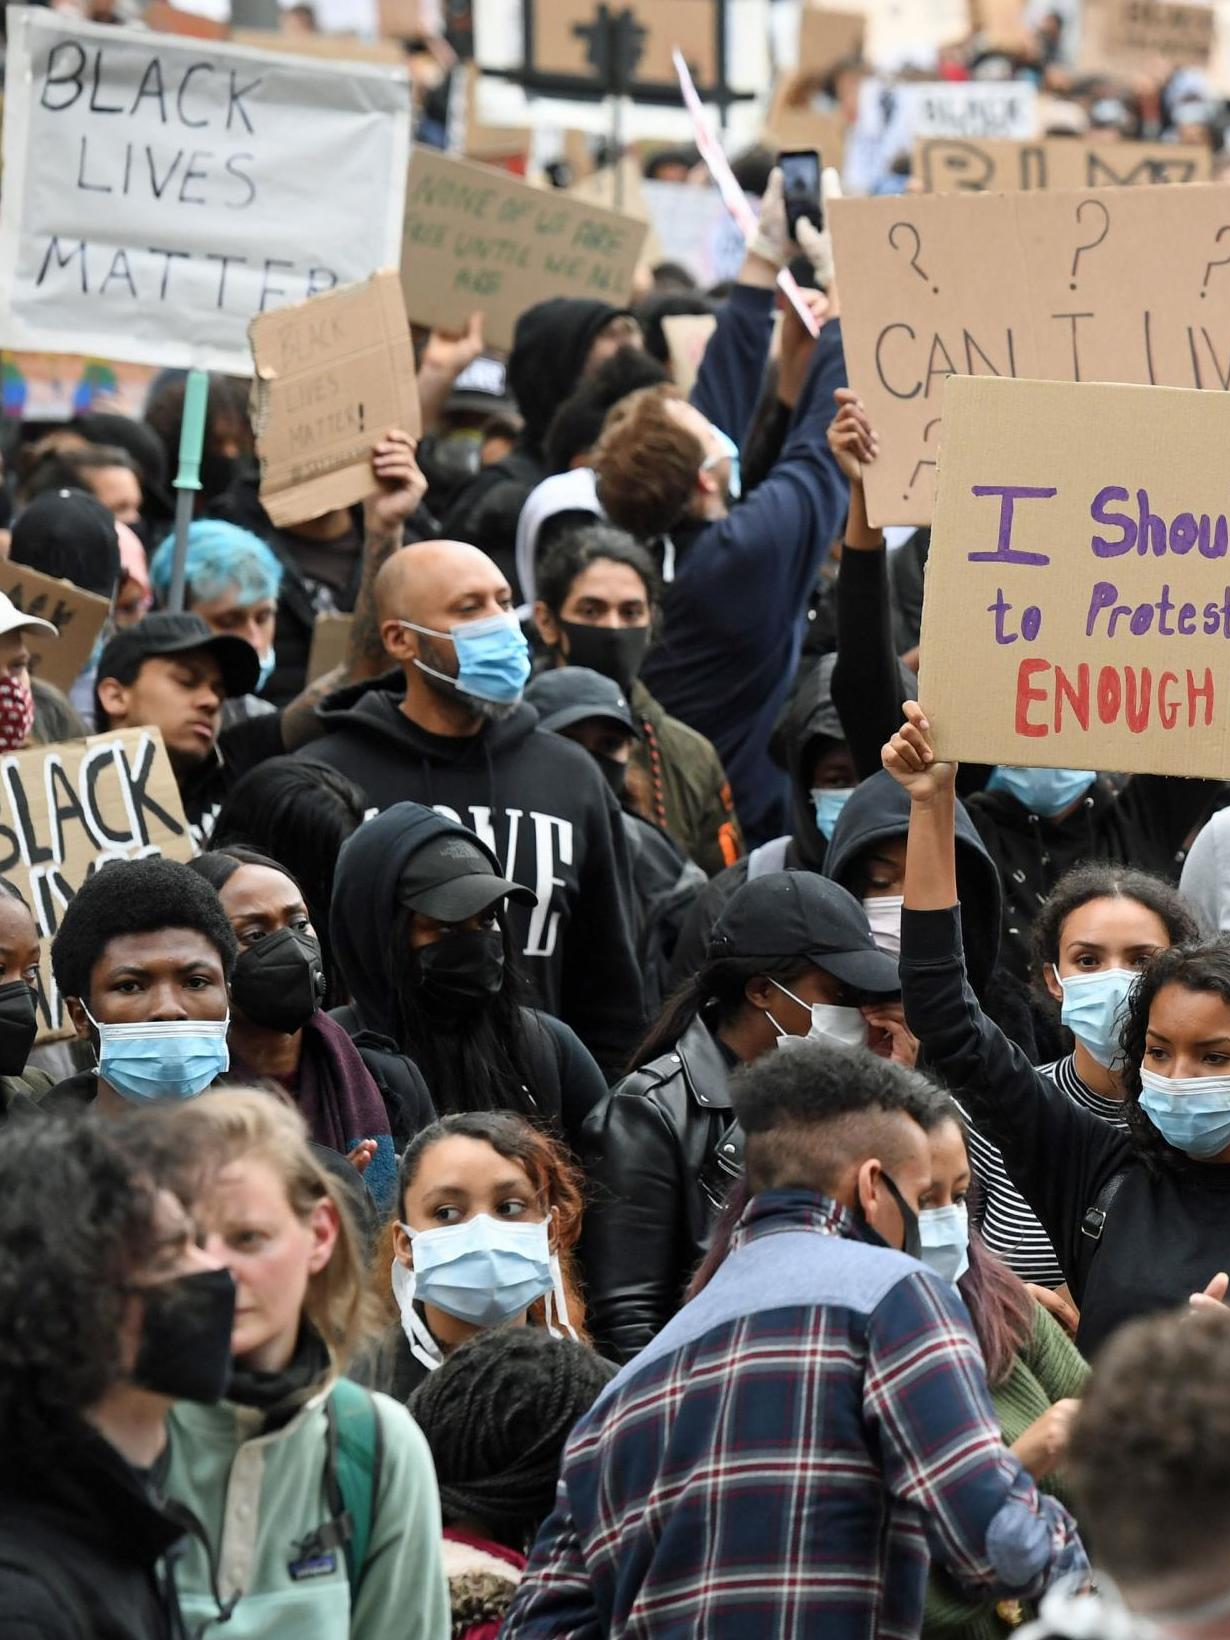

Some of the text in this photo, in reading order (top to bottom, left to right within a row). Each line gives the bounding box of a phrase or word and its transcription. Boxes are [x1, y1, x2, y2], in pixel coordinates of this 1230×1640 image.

[41, 40, 263, 134] BLACK
[78, 136, 256, 209] LIVES
[875, 323, 1015, 398] CAN
[968, 486, 1057, 566] I
[987, 588, 1041, 644] to
[1015, 658, 1214, 738] ENOUGH
